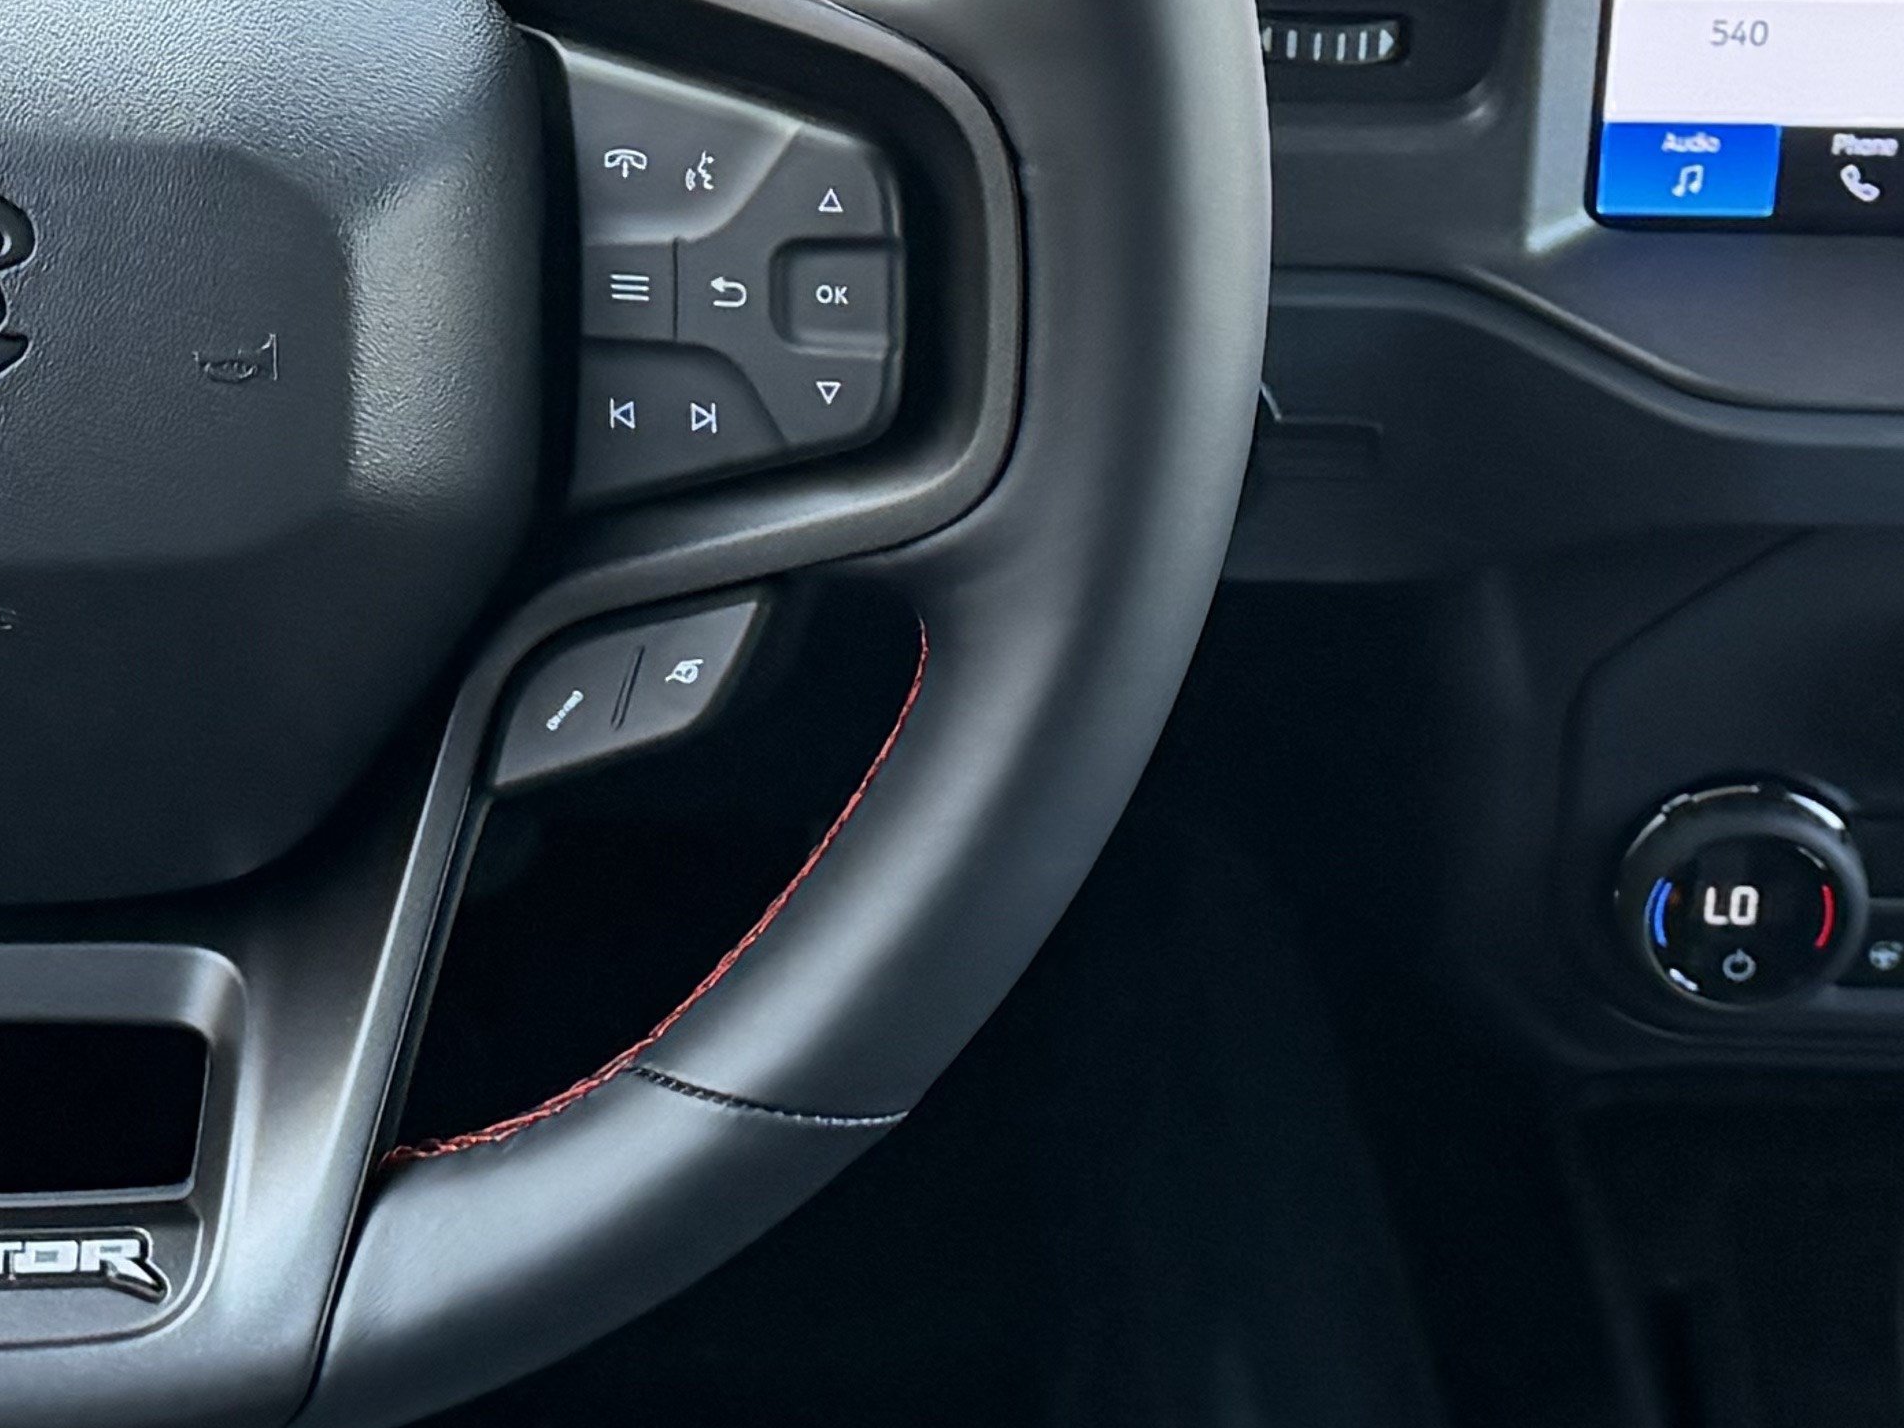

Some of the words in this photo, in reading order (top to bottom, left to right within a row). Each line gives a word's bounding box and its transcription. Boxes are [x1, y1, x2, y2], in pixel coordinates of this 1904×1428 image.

[1709, 20, 1770, 49] 540
[1661, 131, 1721, 155] Audio
[1831, 132, 1899, 158] Phone
[815, 283, 849, 306] OK
[1703, 884, 1761, 928] LO
